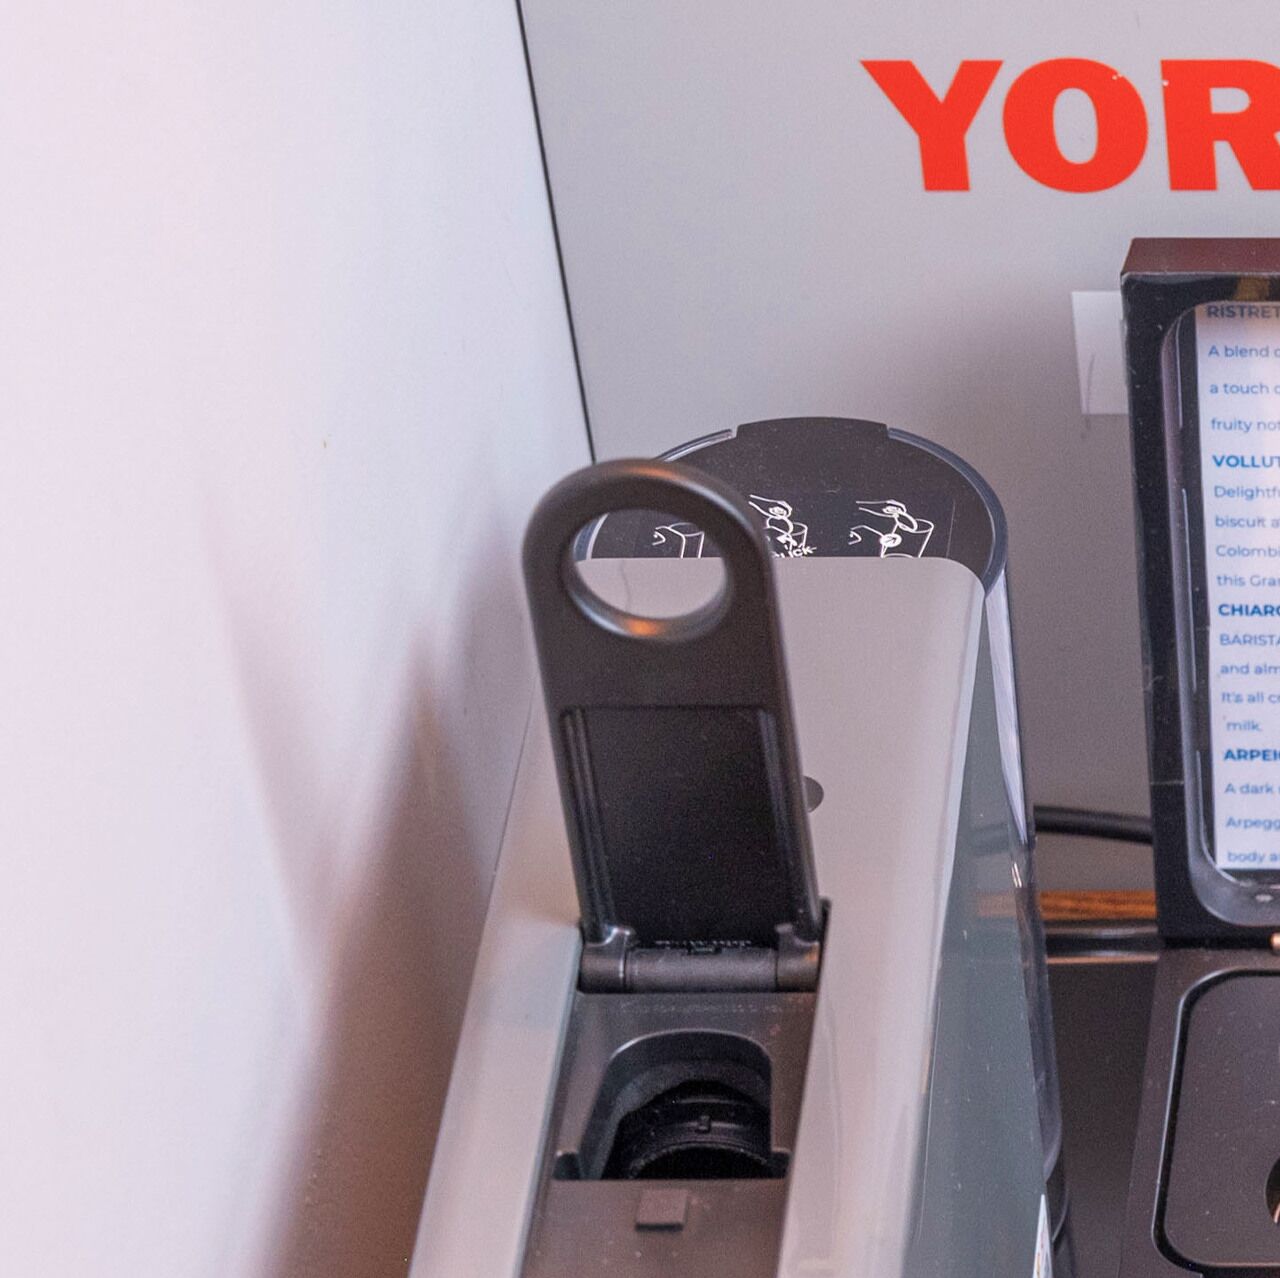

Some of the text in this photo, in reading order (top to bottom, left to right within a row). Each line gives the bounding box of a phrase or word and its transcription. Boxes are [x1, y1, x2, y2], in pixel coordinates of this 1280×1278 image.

[1207, 344, 1220, 357] A
[1223, 345, 1270, 358] blend
[1209, 383, 1219, 394] a
[1222, 382, 1270, 396] touch
[1210, 417, 1253, 434] fruity
[1214, 515, 1266, 529] biscuit
[1215, 574, 1246, 587] this
[1219, 662, 1251, 675] and
[1221, 692, 1244, 705] It's
[1246, 691, 1265, 704] all
